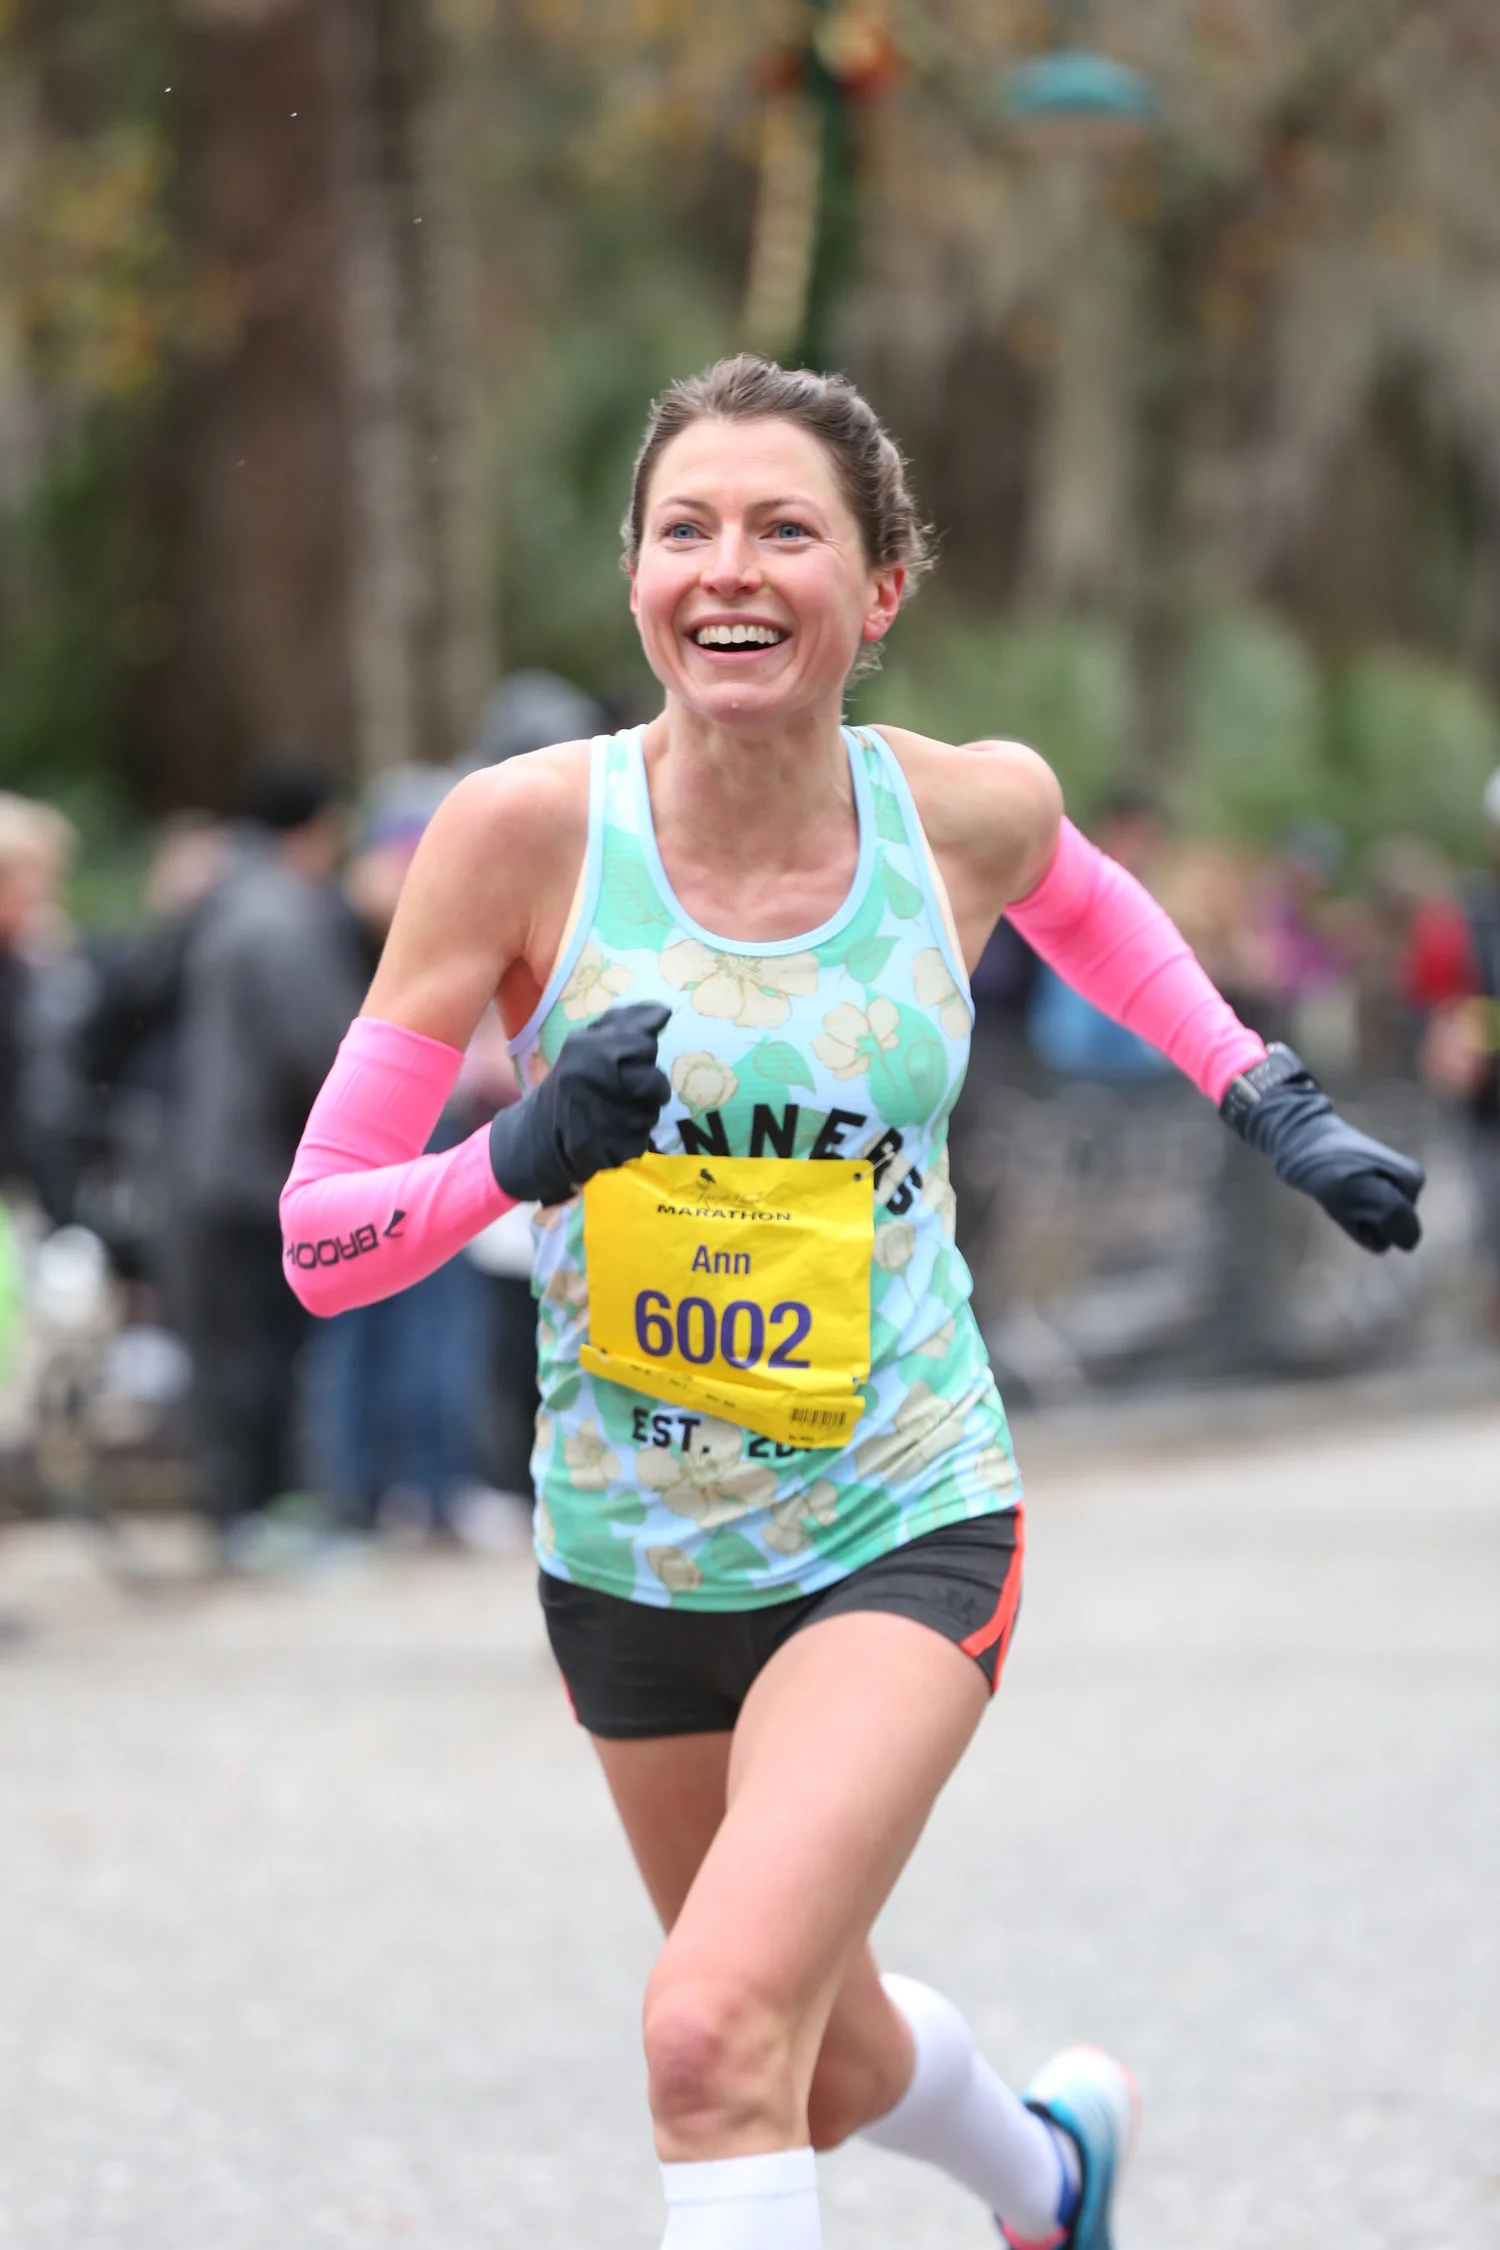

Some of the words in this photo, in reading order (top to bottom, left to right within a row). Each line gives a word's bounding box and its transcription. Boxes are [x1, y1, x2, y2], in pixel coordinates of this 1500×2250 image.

[648, 1103, 923, 1216] NNERS
[656, 1204, 792, 1221] MARATHON
[691, 1244, 751, 1275] Ann
[635, 1289, 812, 1370] 6002
[632, 1406, 710, 1452] EST.
